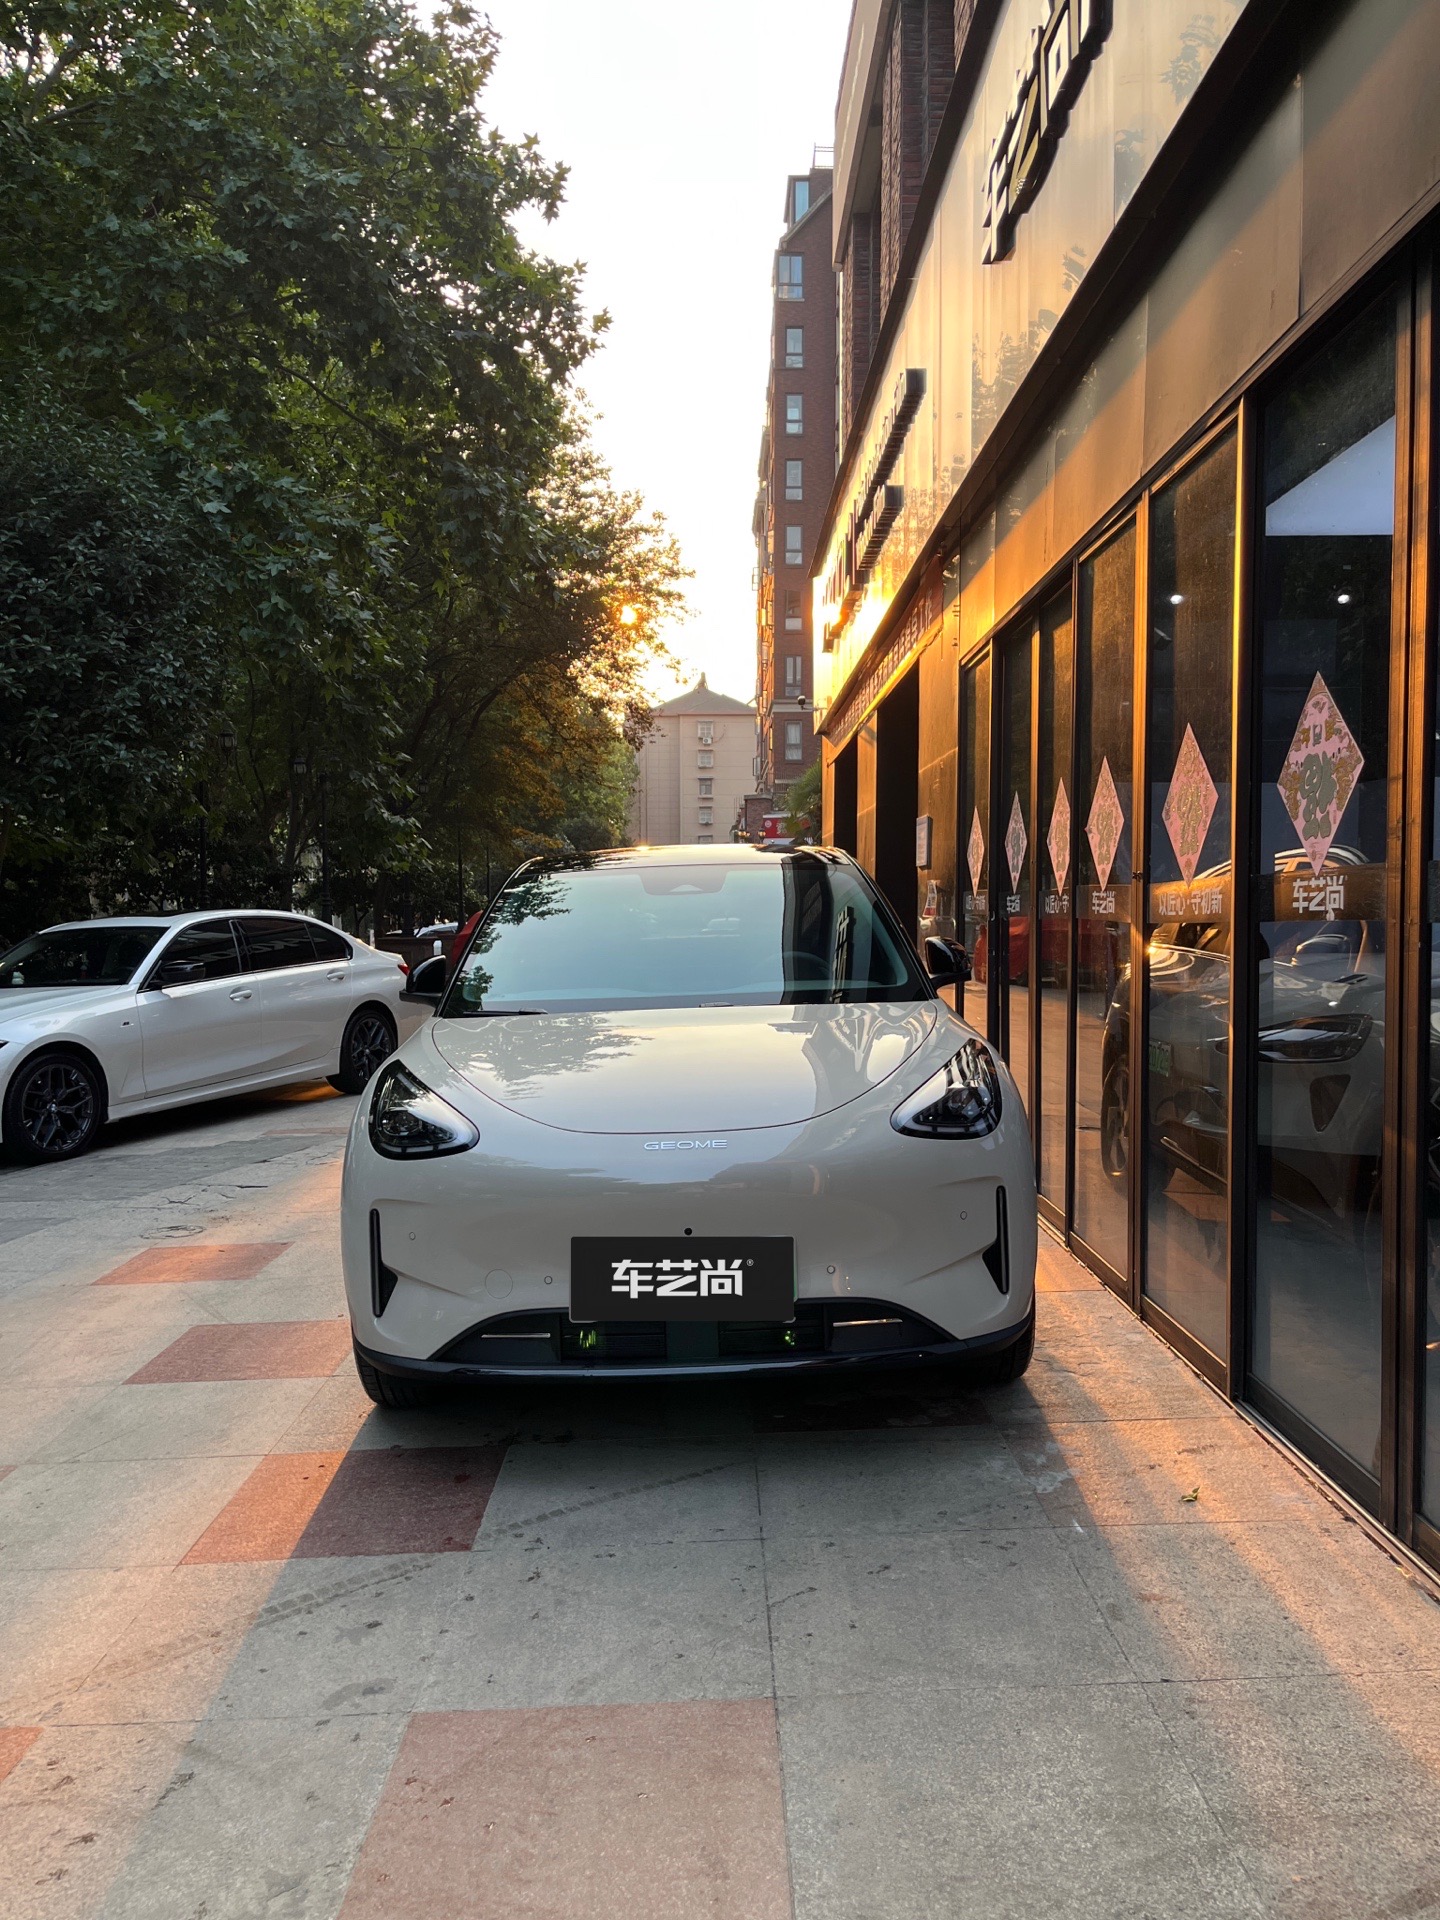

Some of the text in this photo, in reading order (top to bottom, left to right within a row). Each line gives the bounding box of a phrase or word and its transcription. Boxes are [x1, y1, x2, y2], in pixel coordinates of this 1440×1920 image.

[1092, 890, 1116, 915] 车艺尚
[1292, 875, 1345, 914] 车艺尚
[643, 1139, 729, 1150] GEOME
